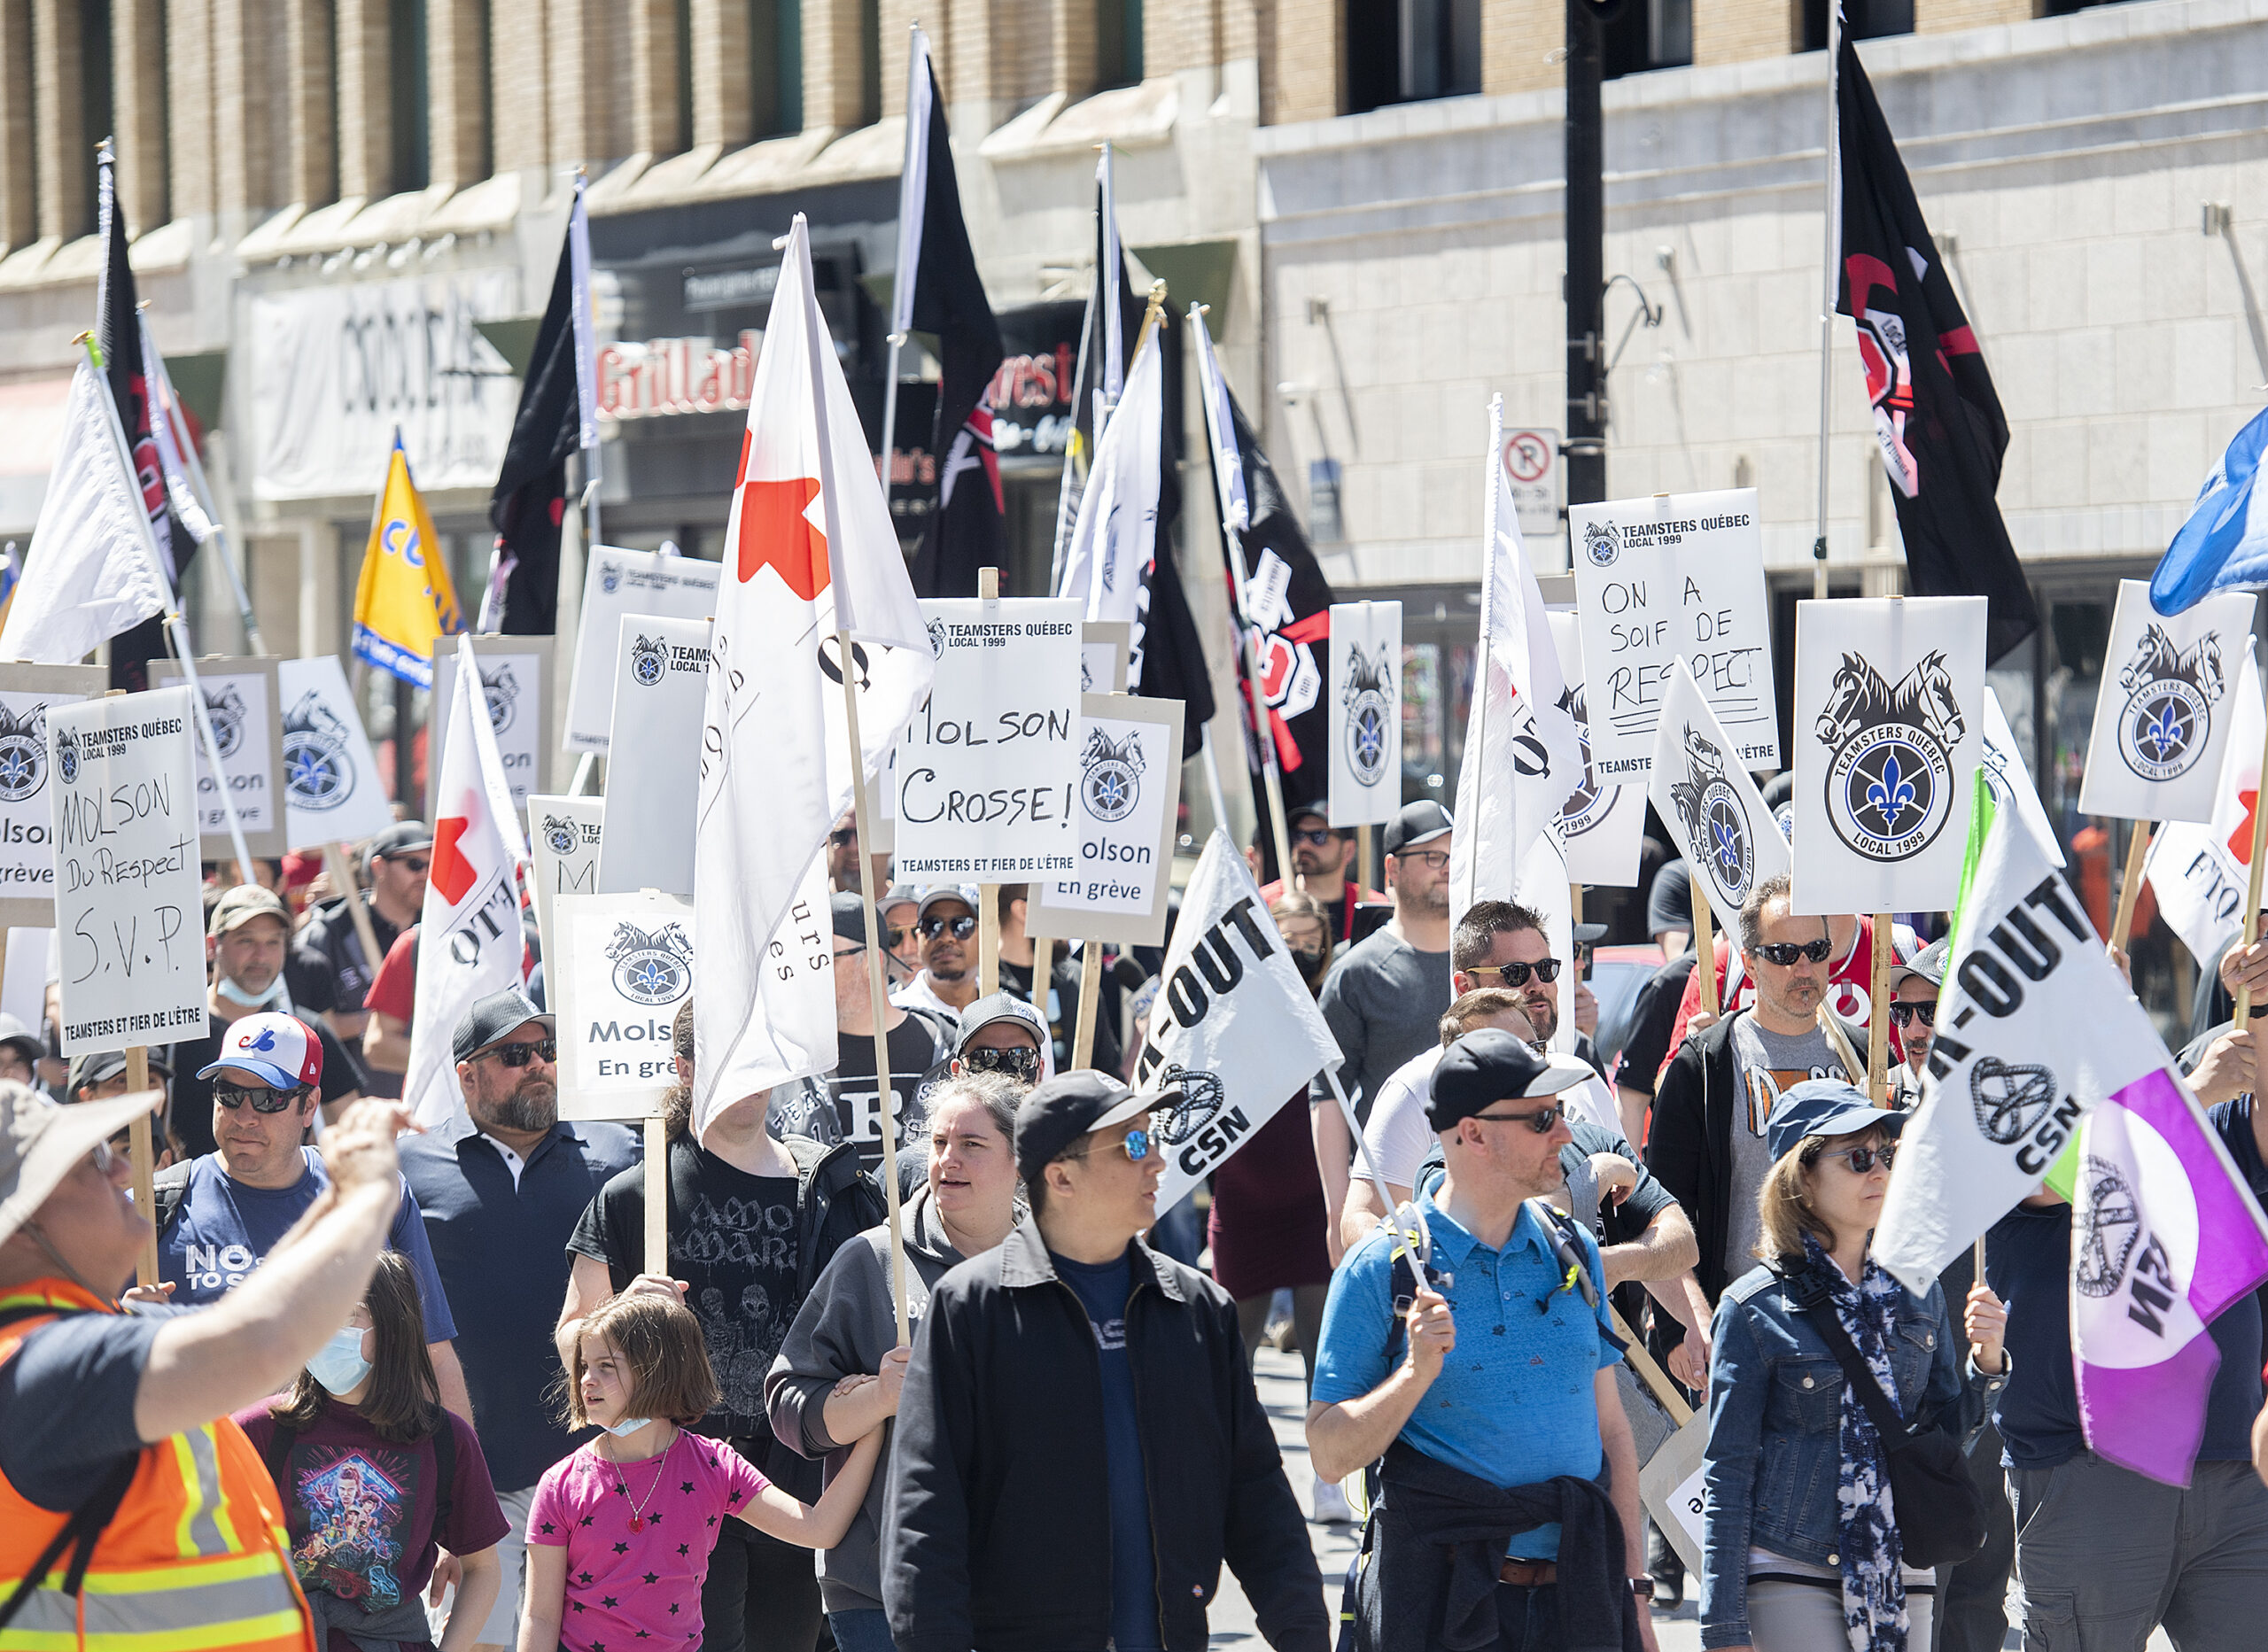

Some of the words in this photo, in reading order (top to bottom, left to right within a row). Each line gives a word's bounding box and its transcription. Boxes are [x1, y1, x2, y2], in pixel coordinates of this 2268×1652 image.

[592, 329, 764, 422] Grillad
[1622, 519, 1697, 538] TEAMSTERS
[1701, 514, 1750, 531] QUÉBEC
[1623, 537, 1655, 549] LOCAL
[1658, 534, 1682, 545] 1999
[1601, 580, 1647, 615] ON
[1682, 576, 1703, 606] A
[949, 624, 1021, 637] TEAMSTERS
[1025, 621, 1073, 637] QUÉBEC
[1610, 619, 1668, 653] SOIF
[1696, 609, 1733, 642] DE
[949, 637, 979, 648] LOCAL
[983, 637, 1006, 648] 1999
[670, 660, 702, 673] LOCAL
[2128, 681, 2182, 714] TEAMSTERS
[82, 725, 138, 748] TEAMSTERS
[141, 717, 182, 739] QUÉBEC
[82, 747, 105, 762] LOCAL
[107, 743, 127, 757] 1999
[1835, 726, 1903, 777] TEAMSTERS
[1908, 730, 1946, 775] QUÉBEC
[1598, 757, 1651, 774] TEAMSTE
[197, 773, 264, 793] oon
[60, 772, 171, 854] MOLSON
[1564, 814, 1592, 832] 1999
[0, 818, 52, 843] lso
[582, 835, 601, 845] LOC
[1701, 797, 1716, 873] TEAMSTERS
[1082, 837, 1152, 864] olson
[1852, 832, 1891, 855] LOCAL
[1896, 831, 1926, 854] 1999
[0, 862, 54, 882] rève
[902, 859, 971, 872] TEAMSTERS
[973, 858, 990, 871] ET
[991, 857, 1017, 871] FIER
[1020, 857, 1035, 869] DE
[1037, 854, 1074, 869] L'ÊTRE
[1087, 880, 1142, 901] grève
[617, 950, 657, 972] TEAMSTERS
[630, 993, 653, 1003] LOCAL
[65, 1020, 114, 1042] TEAMSTERS
[116, 1015, 128, 1035] ET
[129, 1012, 151, 1033] FIER
[152, 1011, 167, 1029] DE
[167, 1005, 201, 1028] L'ÊTRE
[588, 1020, 672, 1043] Mols
[599, 1060, 629, 1076] En
[639, 1057, 679, 1079] grè
[1178, 1105, 1252, 1176] CSN
[2015, 1094, 2084, 1177] CSN
